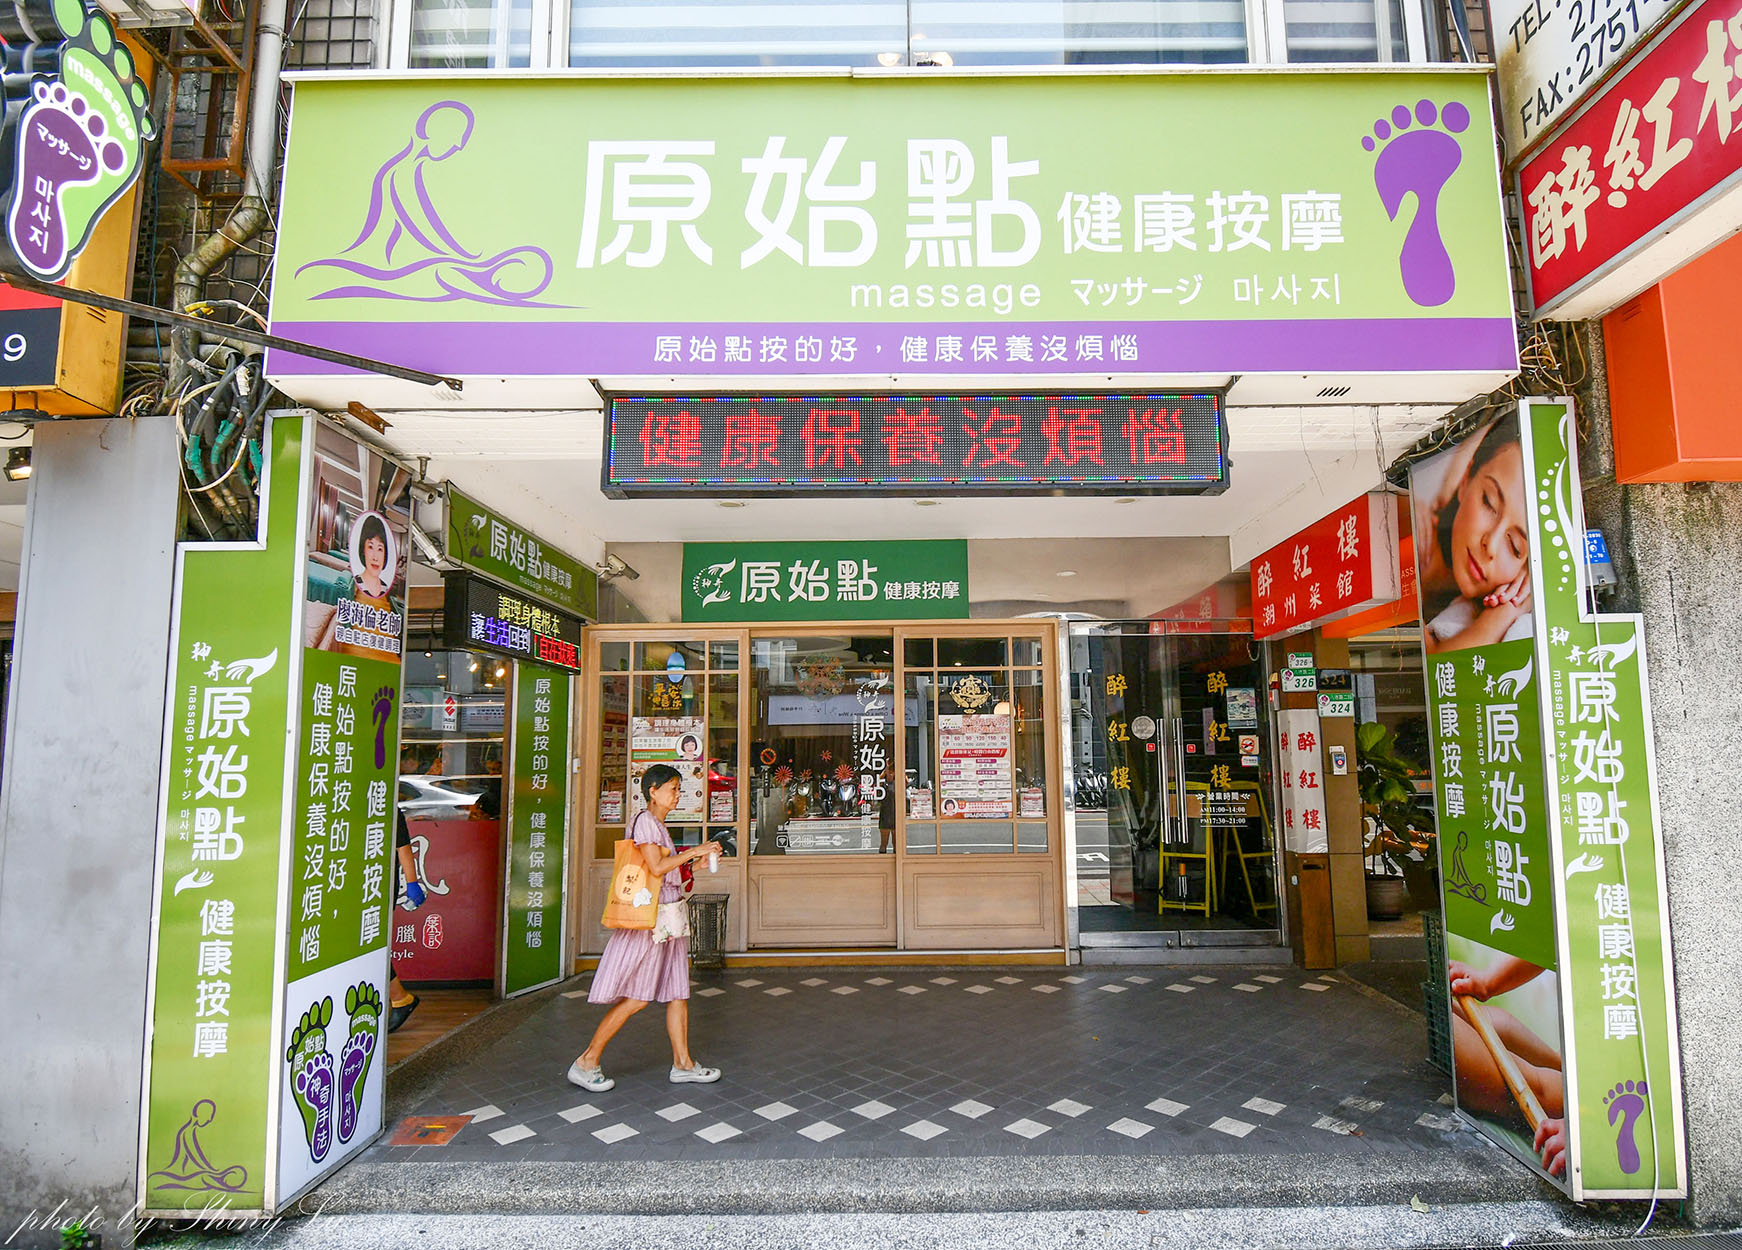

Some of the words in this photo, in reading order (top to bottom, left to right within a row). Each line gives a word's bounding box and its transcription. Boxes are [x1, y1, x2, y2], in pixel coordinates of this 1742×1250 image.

[67, 55, 136, 141] massage
[35, 122, 93, 171] マッサージ
[28, 175, 52, 255] 마사지
[575, 135, 1042, 270] 原始點
[1057, 190, 1345, 255] 健康按摩
[850, 279, 1042, 315] massage
[1069, 277, 1203, 307] マッサージ
[1233, 273, 1343, 306] 마사지
[3, 333, 27, 361] 9
[653, 333, 1140, 363] 原始點按的好，健康保養沒煩惱
[638, 406, 1188, 470] 健康保養沒煩惱
[490, 520, 542, 580] 原始點
[739, 559, 879, 604] 原始點
[882, 580, 961, 601] 健康按摩
[1257, 514, 1360, 599] 醉紅樓
[336, 597, 401, 637] 廖海倫老師
[498, 593, 560, 638] 調理身體根本
[1262, 570, 1354, 627] 潮州菜館
[184, 685, 197, 741] massage
[1295, 678, 1314, 688] 326
[1330, 704, 1350, 713] 324
[1553, 670, 1565, 726] massage
[859, 715, 886, 801] 原始點
[1107, 673, 1131, 790] 醉紅樓
[1207, 672, 1231, 789] 醉紅樓
[1435, 661, 1465, 818] 健康按摩
[1475, 703, 1486, 765] massage
[1557, 732, 1570, 784] マッサージ
[1568, 671, 1630, 846] 原始點
[181, 745, 195, 801] マッサージ
[191, 685, 253, 863] 原始點
[326, 664, 358, 920] 原始點按的好，
[1280, 731, 1293, 829] 醉紅樓
[1297, 730, 1322, 831] 醉紅樓
[1480, 770, 1490, 829] マッサージ
[1485, 703, 1531, 906] 原始點
[179, 808, 191, 842] 마사지
[299, 681, 334, 964] 健康保養沒煩惱
[525, 678, 552, 949] 原始點按的好，健康保養沒煩惱
[1561, 793, 1573, 826] 마사지
[359, 779, 388, 947] 健康按摩
[193, 898, 236, 1058] 健康按摩
[1593, 883, 1638, 1041] 健康按摩
[351, 1014, 377, 1027] massage
[294, 1034, 325, 1072] 原始點
[310, 1075, 331, 1150] 神奇手法
